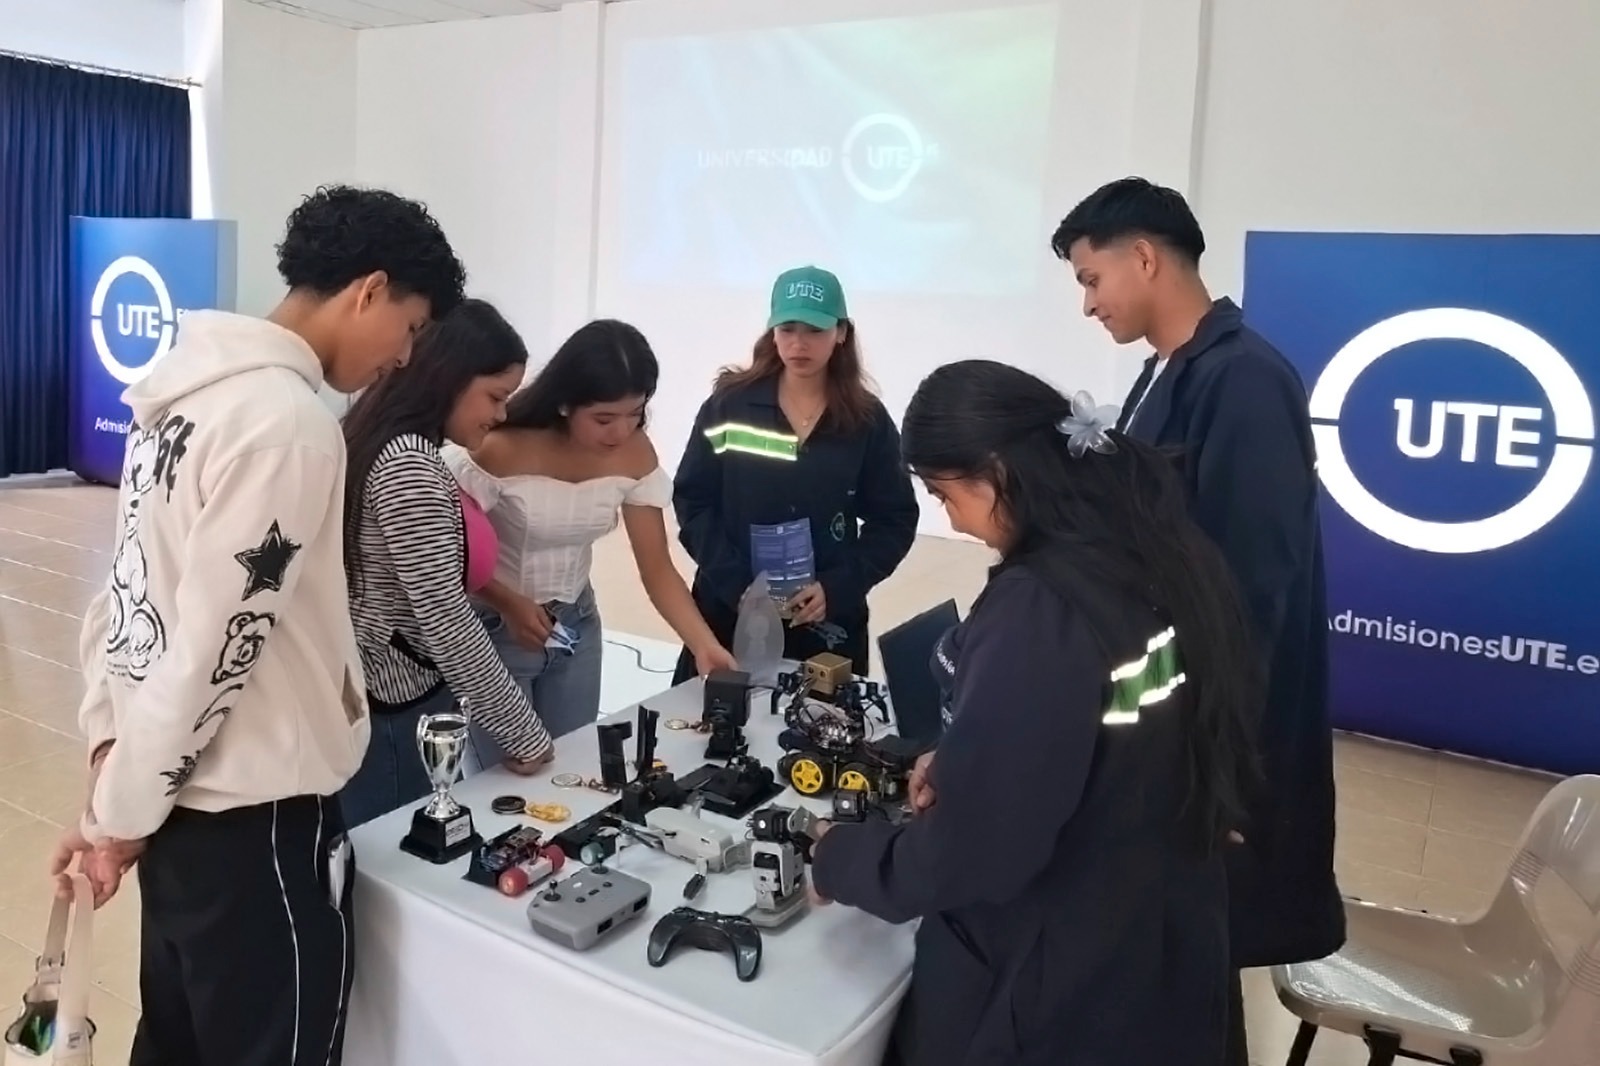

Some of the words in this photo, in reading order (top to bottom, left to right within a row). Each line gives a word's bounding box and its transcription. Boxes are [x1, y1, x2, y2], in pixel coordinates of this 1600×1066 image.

[697, 145, 833, 169] UNIVERSIDAD
[867, 145, 910, 170] UTE
[785, 280, 824, 301] UTE
[116, 303, 161, 339] UTE
[1394, 398, 1543, 468] UTE
[1327, 609, 1600, 675] dmisionesUTE.e
